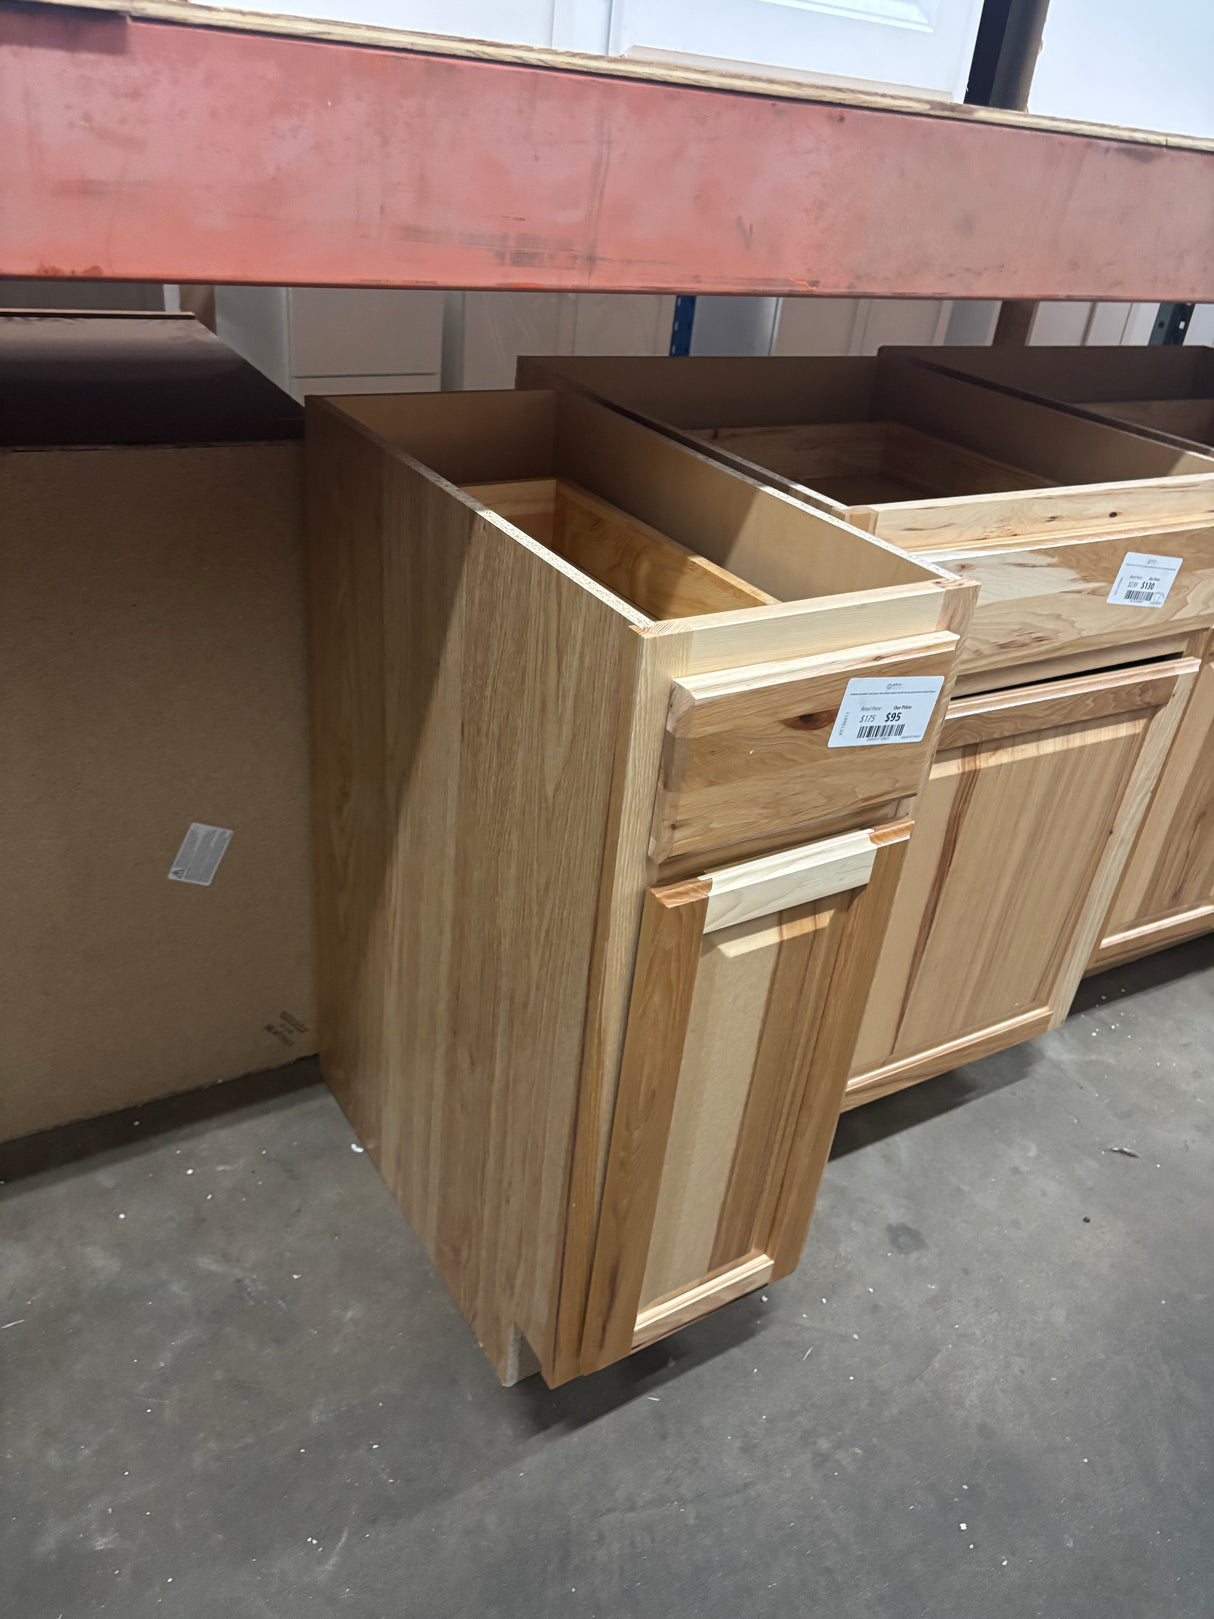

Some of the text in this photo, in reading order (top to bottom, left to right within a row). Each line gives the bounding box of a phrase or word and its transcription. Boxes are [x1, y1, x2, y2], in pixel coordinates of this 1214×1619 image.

[1140, 581, 1155, 590] $130
[859, 711, 902, 723] $175 $95
